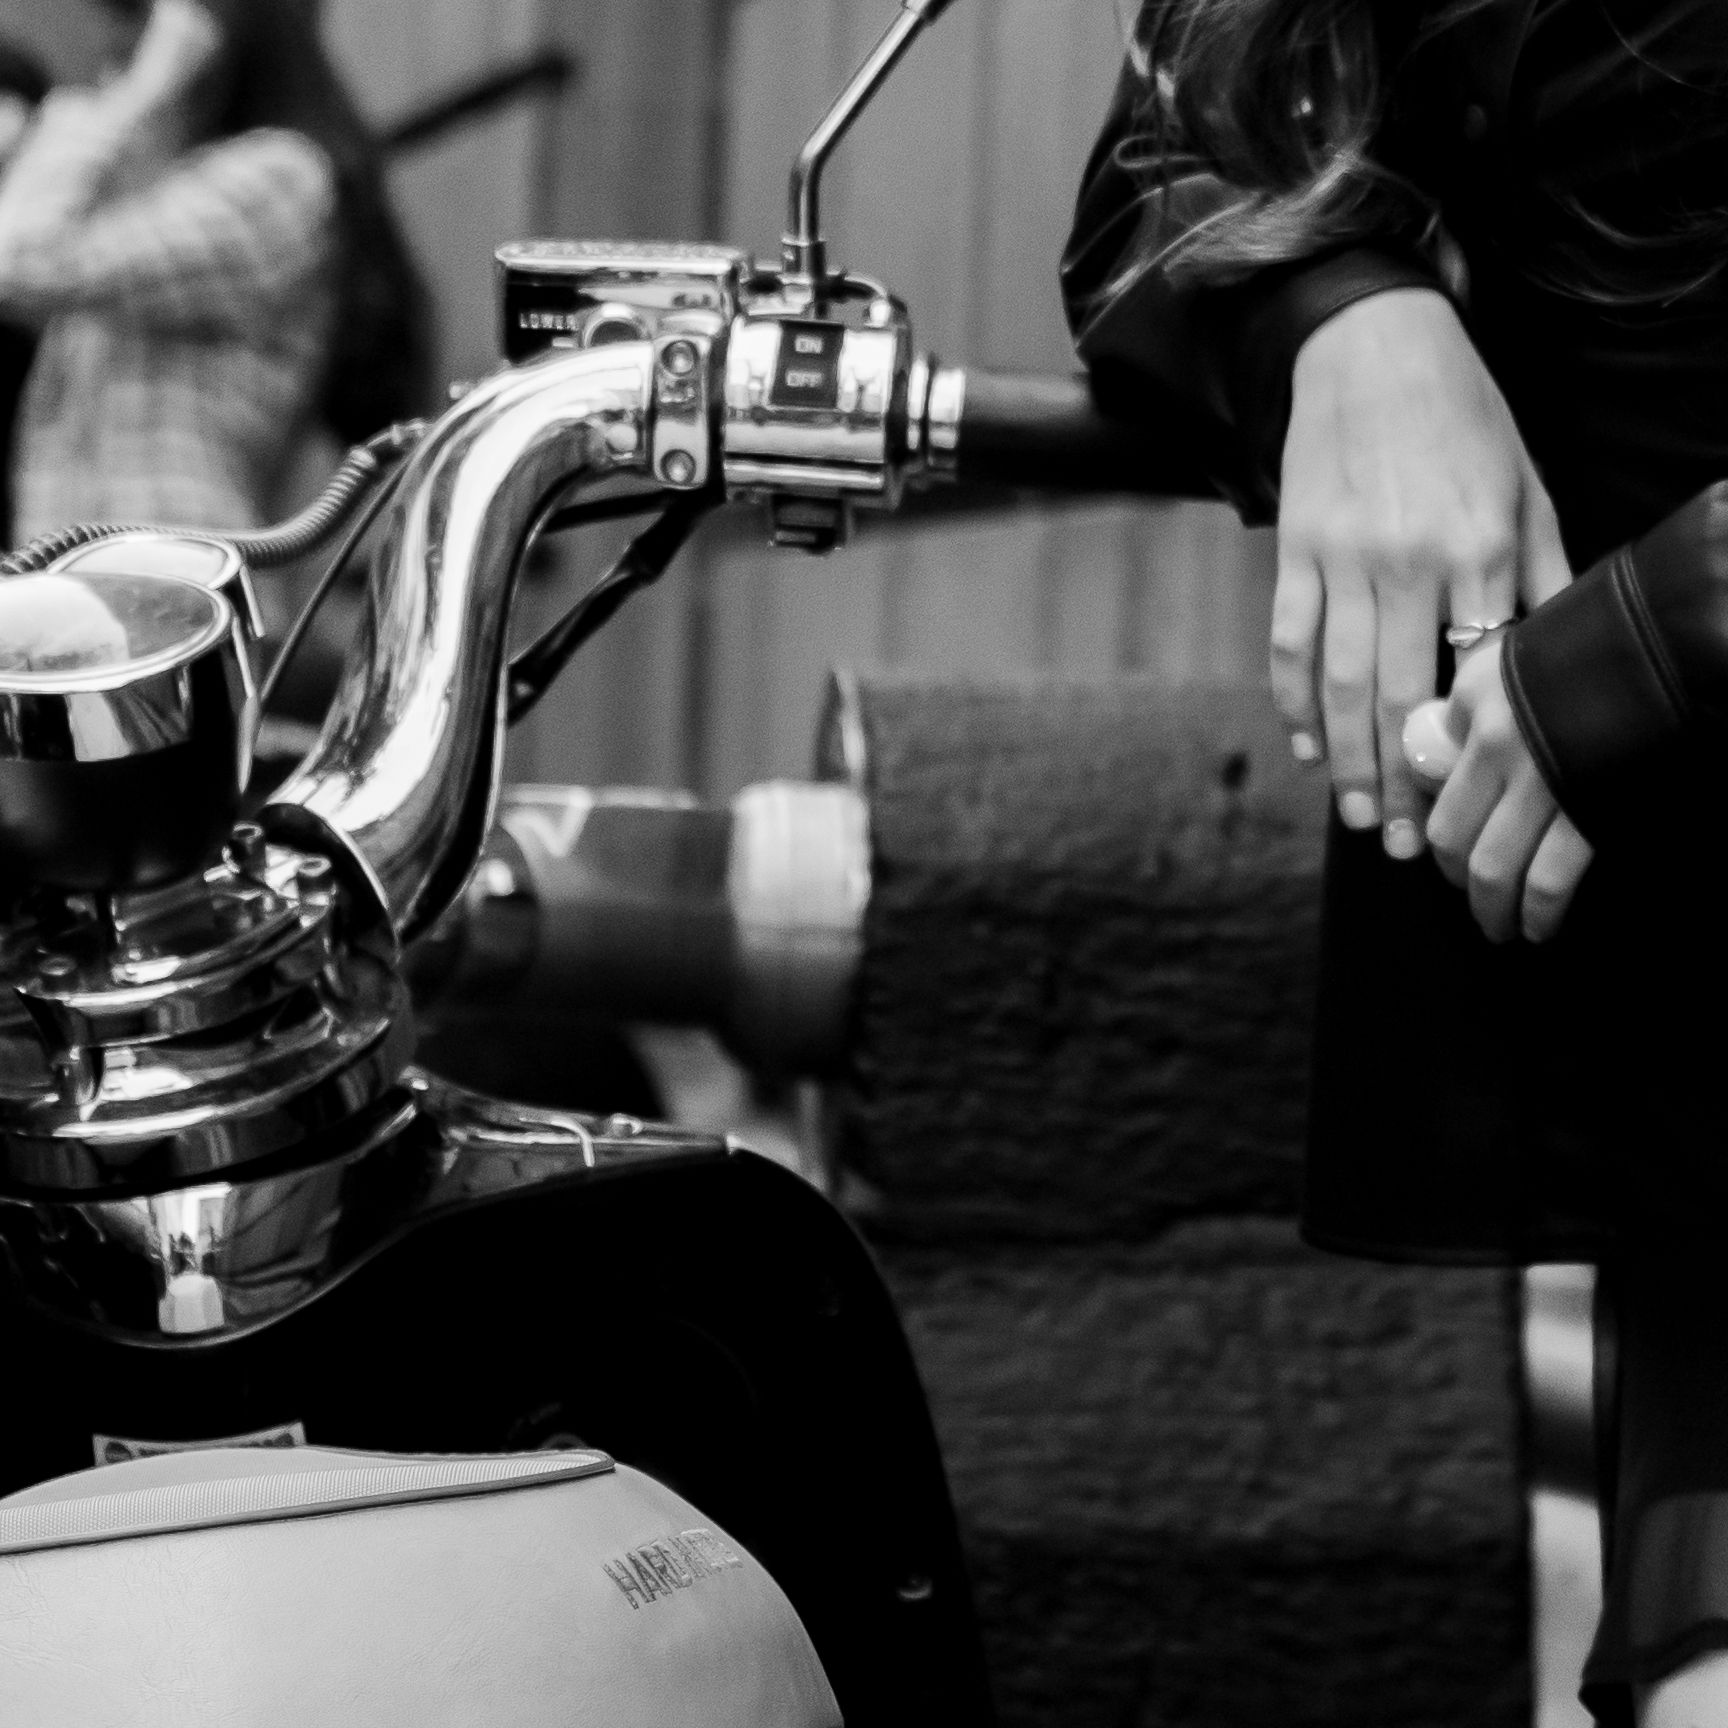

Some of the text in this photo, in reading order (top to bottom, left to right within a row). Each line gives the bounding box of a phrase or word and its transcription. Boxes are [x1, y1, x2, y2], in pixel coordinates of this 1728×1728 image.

[520, 313, 577, 331] LOWER
[795, 334, 822, 354] ON
[787, 371, 823, 388] OFF
